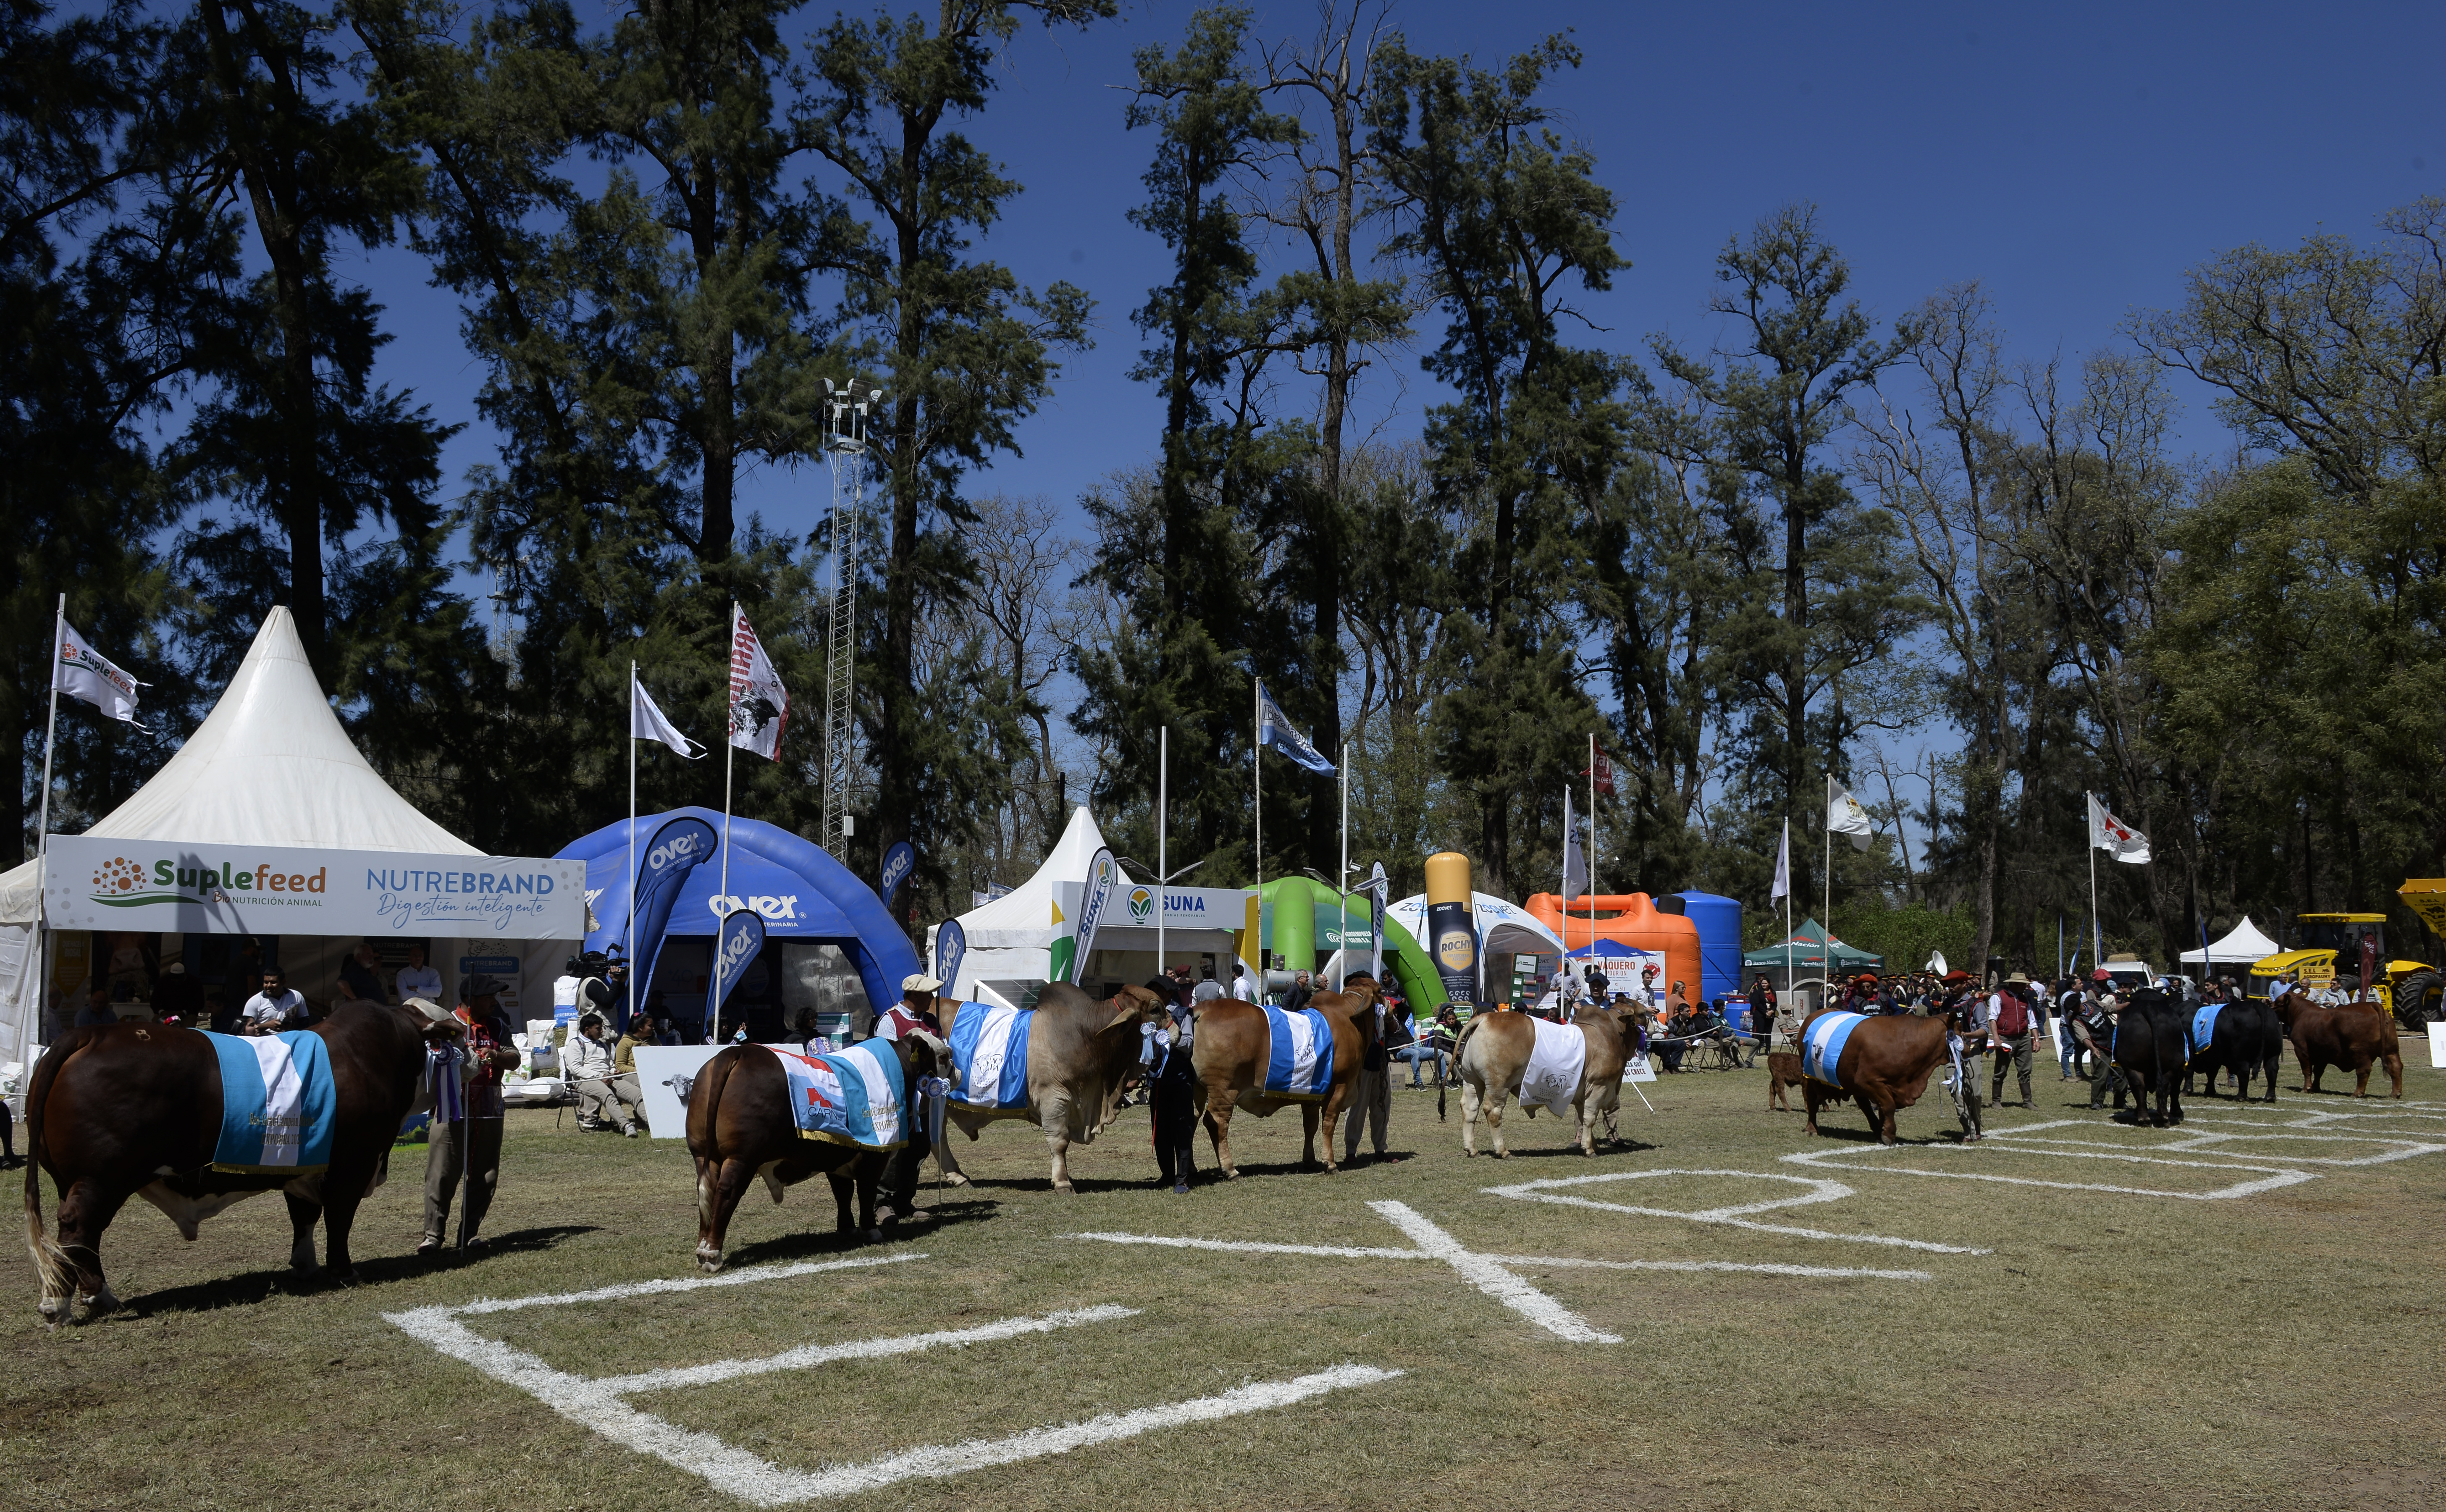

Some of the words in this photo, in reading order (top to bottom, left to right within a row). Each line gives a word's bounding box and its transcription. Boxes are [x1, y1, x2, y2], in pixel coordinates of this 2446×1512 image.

[649, 832, 699, 869] over
[656, 862, 674, 877] MEDICINA
[674, 851, 702, 865] VETERINARIA
[883, 850, 907, 887] over
[153, 859, 326, 896] Suplefeed
[367, 868, 554, 895] NUTREBRAND
[211, 890, 231, 903] Bio
[232, 896, 284, 906] NUTRICIÓN
[287, 898, 323, 907] ANIMAL
[377, 893, 460, 929] Digestión
[465, 894, 551, 930] inteligente
[709, 895, 798, 919] over
[1081, 890, 1104, 937] SUNA
[1476, 904, 1517, 914] zoovet
[1375, 897, 1383, 939] SUNA
[714, 925, 752, 979] over
[724, 966, 739, 985] MEDICINA
[737, 942, 757, 966] VETERINARIA
[940, 932, 958, 982] over
[1441, 939, 1471, 953] ROCHY
[1598, 961, 1635, 970] VAQUERO
[808, 1106, 840, 1121] CARN
